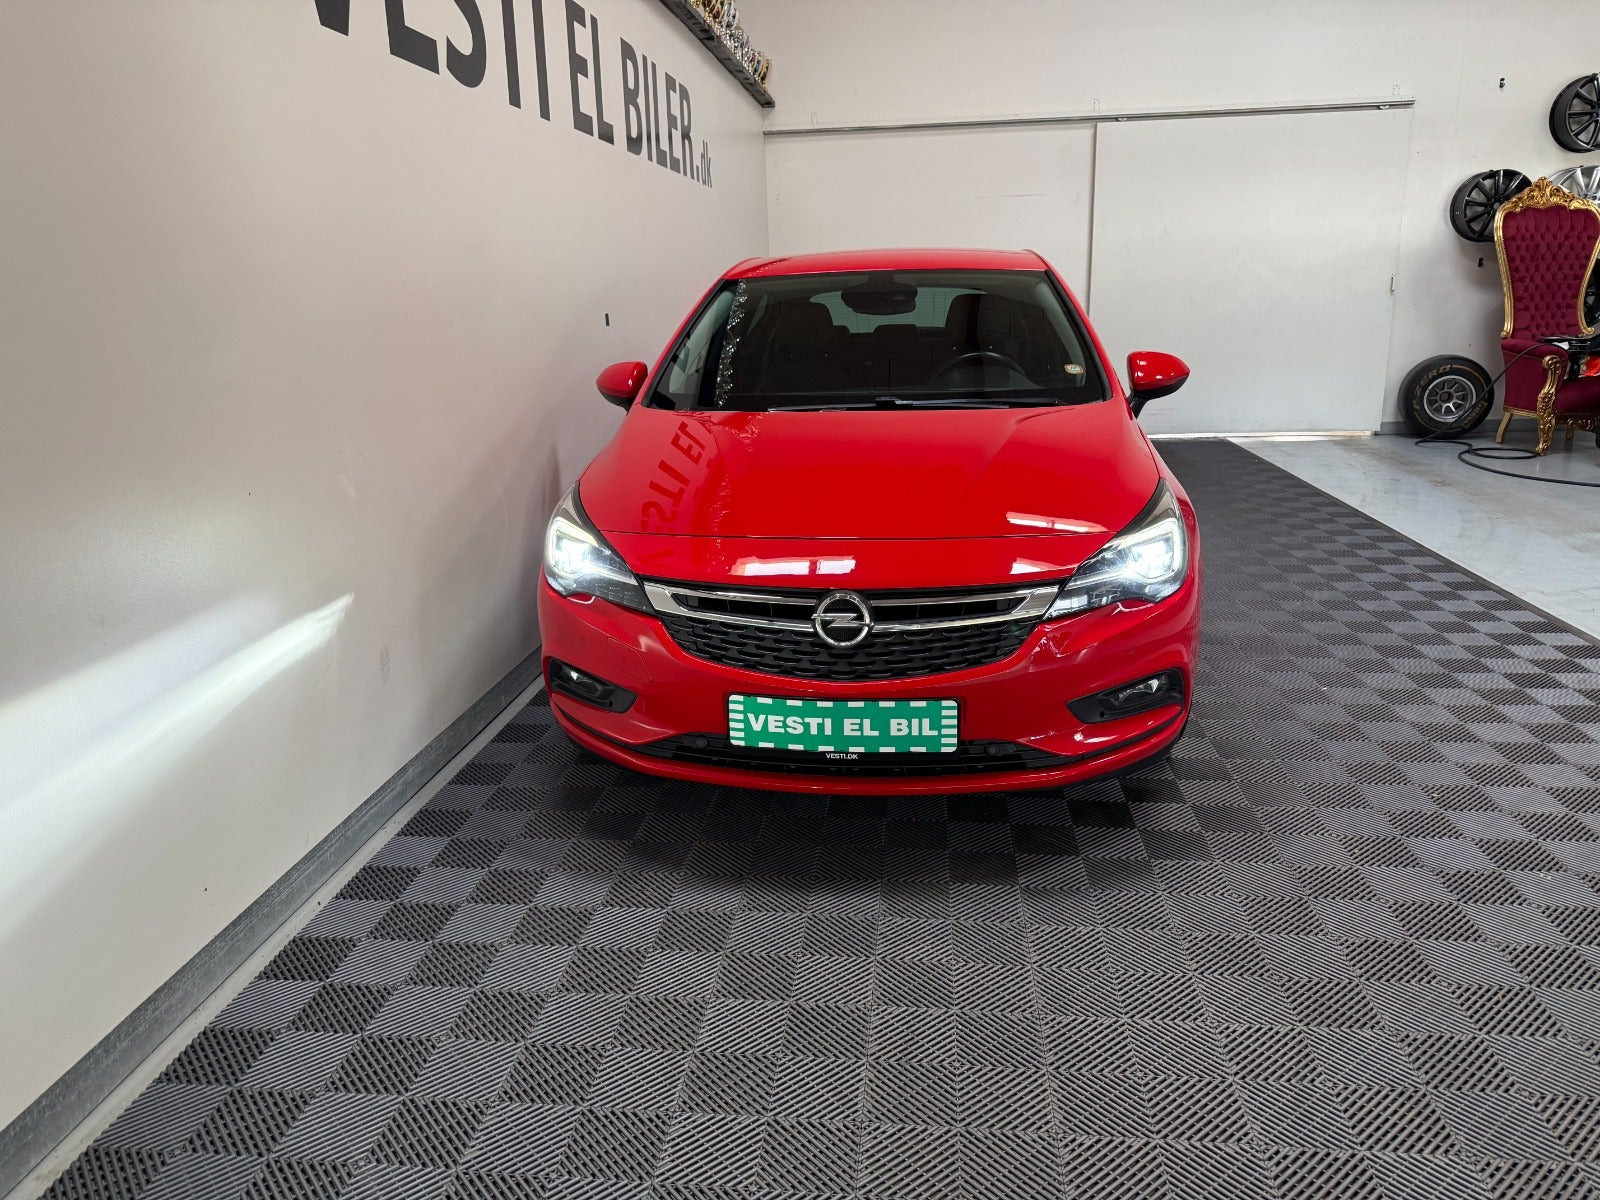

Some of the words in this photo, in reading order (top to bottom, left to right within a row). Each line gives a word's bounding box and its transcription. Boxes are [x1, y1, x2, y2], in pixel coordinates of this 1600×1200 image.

[313, 0, 551, 122] STI
[565, 0, 615, 146] EL
[619, 37, 713, 189] BILER.dk
[747, 713, 832, 736] VESTI
[843, 718, 880, 737] EL
[889, 717, 939, 737] BIL
[825, 752, 859, 760] VESTI.DK
